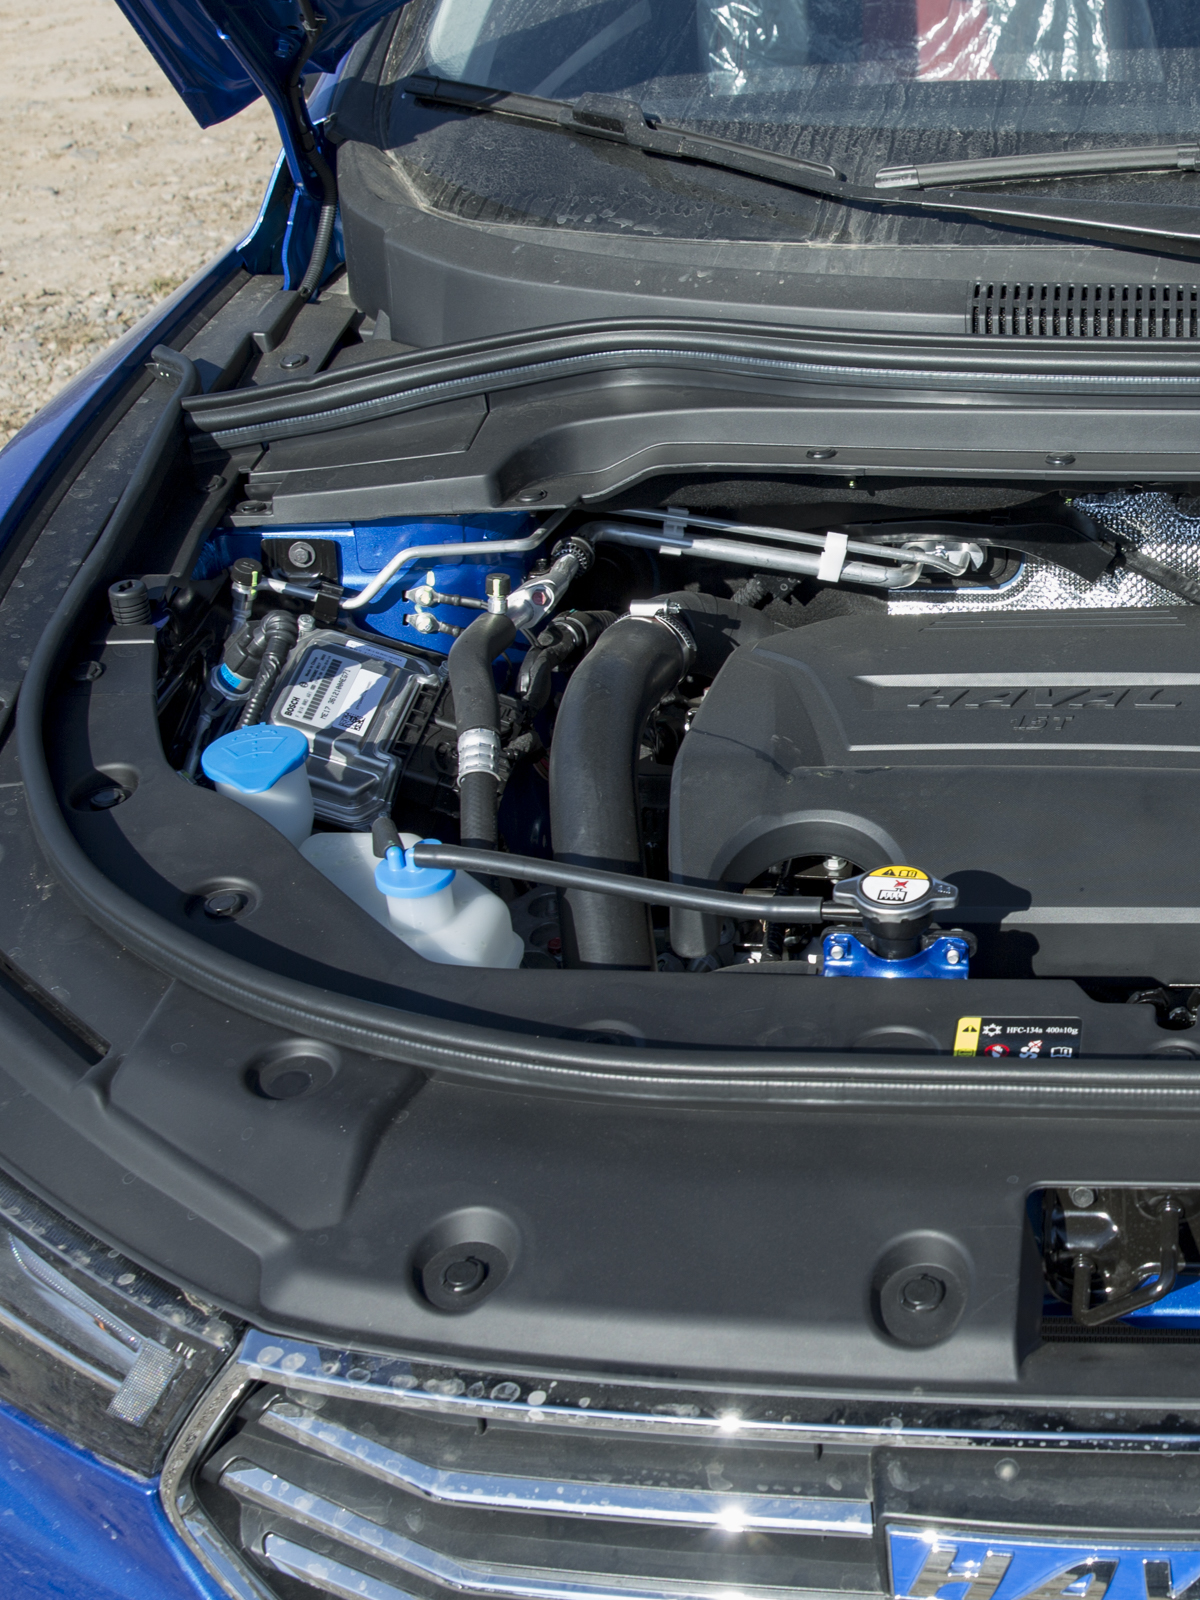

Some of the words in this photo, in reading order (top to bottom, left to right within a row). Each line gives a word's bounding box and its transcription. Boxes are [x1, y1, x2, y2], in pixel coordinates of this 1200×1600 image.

[906, 688, 1182, 707] HAVAL
[284, 697, 300, 716] BOSCH
[320, 706, 331, 719] ME17
[1006, 1026, 1043, 1034] HFC-134a
[1045, 1026, 1079, 1035] 400±10g
